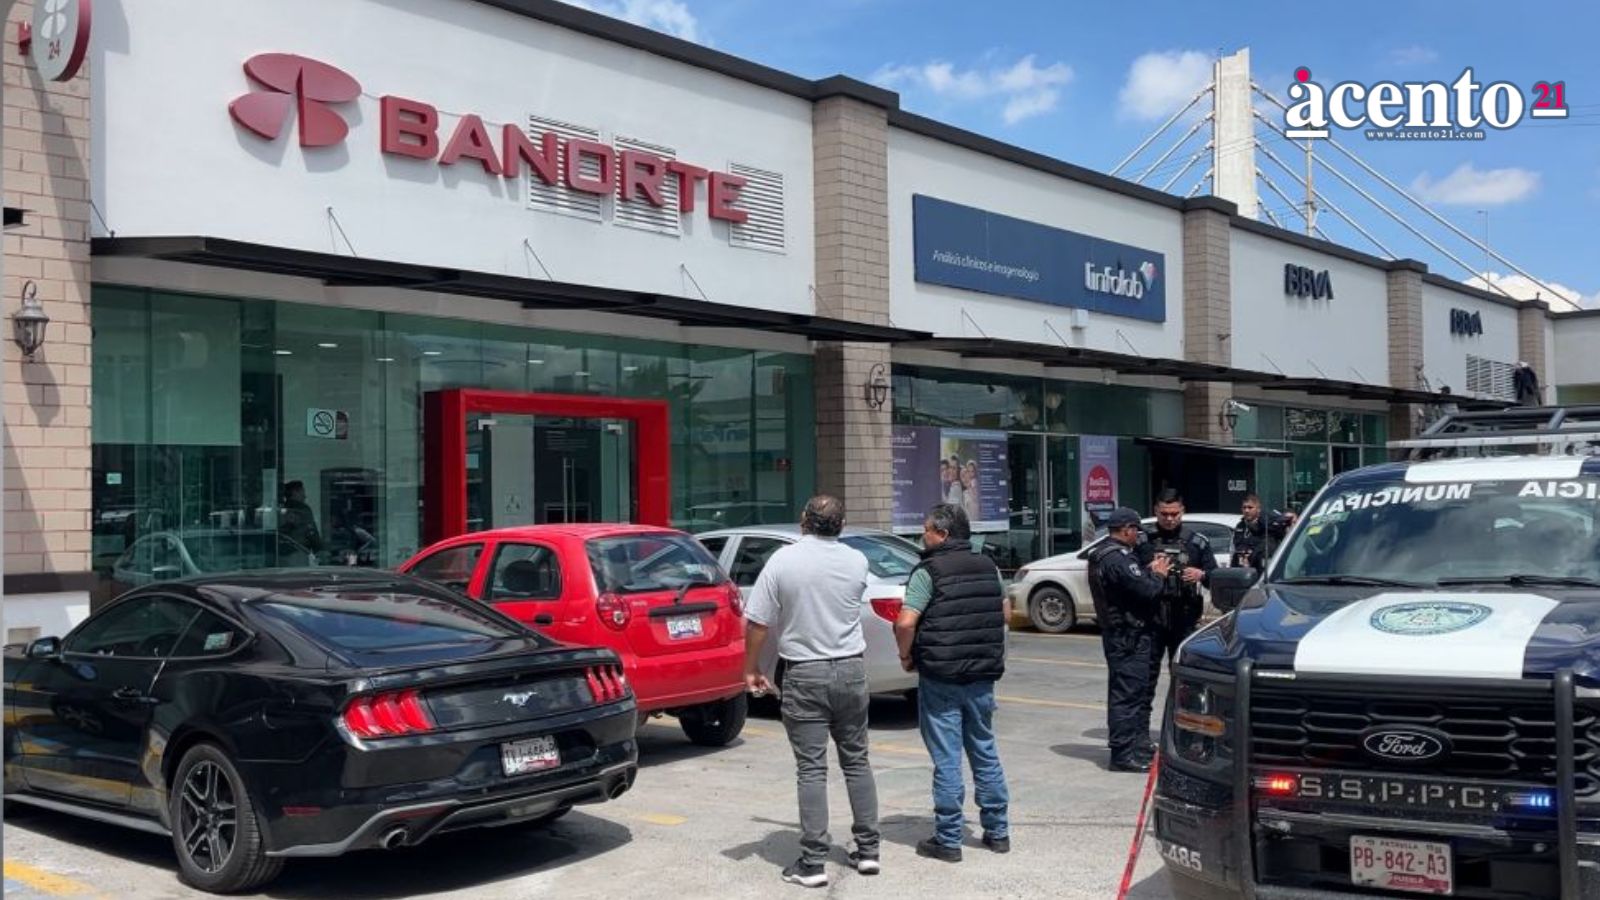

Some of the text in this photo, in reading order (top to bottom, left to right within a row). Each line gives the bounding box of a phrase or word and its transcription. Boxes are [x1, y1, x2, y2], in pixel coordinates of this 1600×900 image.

[48, 38, 60, 60] 24
[380, 95, 749, 225] BANORTE
[1284, 263, 1334, 300] BBVA
[1450, 308, 1483, 337] BBVA
[1378, 734, 1427, 757] Ford
[1353, 846, 1448, 875] PB-842-A3
